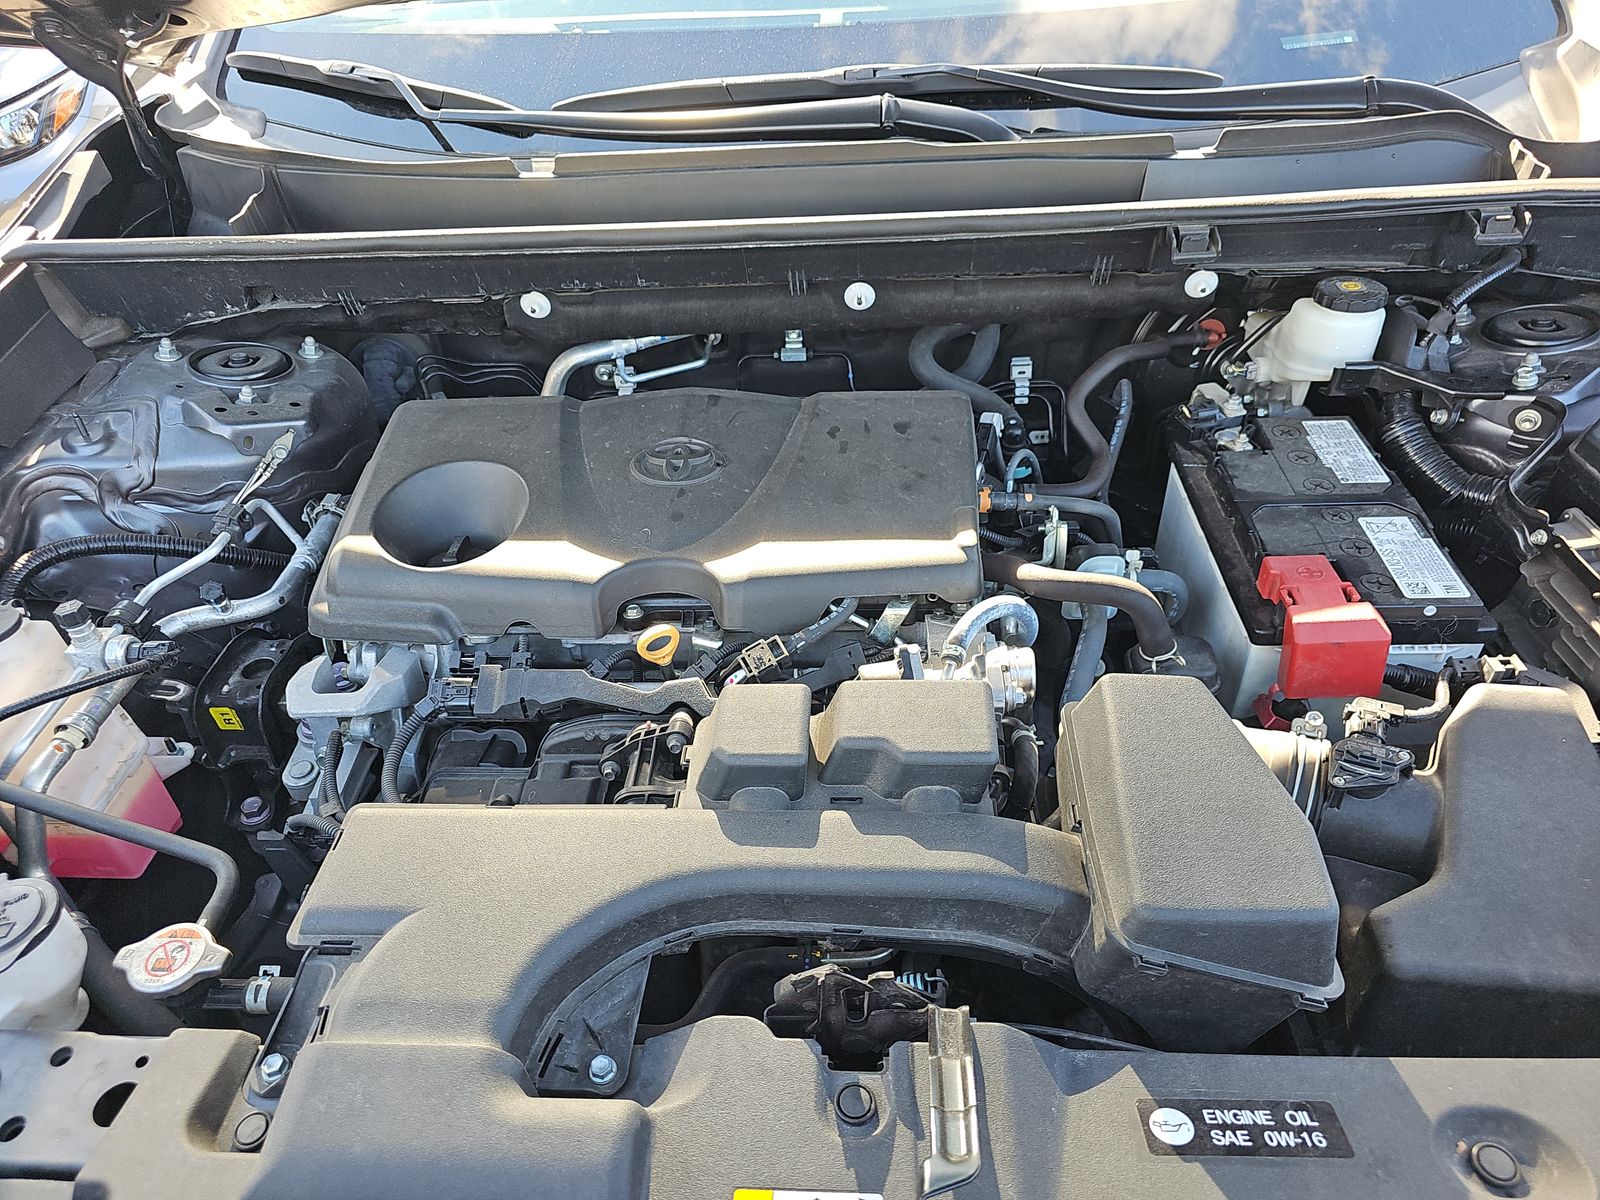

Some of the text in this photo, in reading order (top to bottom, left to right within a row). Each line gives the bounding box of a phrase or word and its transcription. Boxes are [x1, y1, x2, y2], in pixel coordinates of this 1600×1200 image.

[219, 711, 236, 725] R1
[1202, 1108, 1320, 1127] ENGINE OIL
[1209, 1129, 1328, 1148] SAE 0W-16
